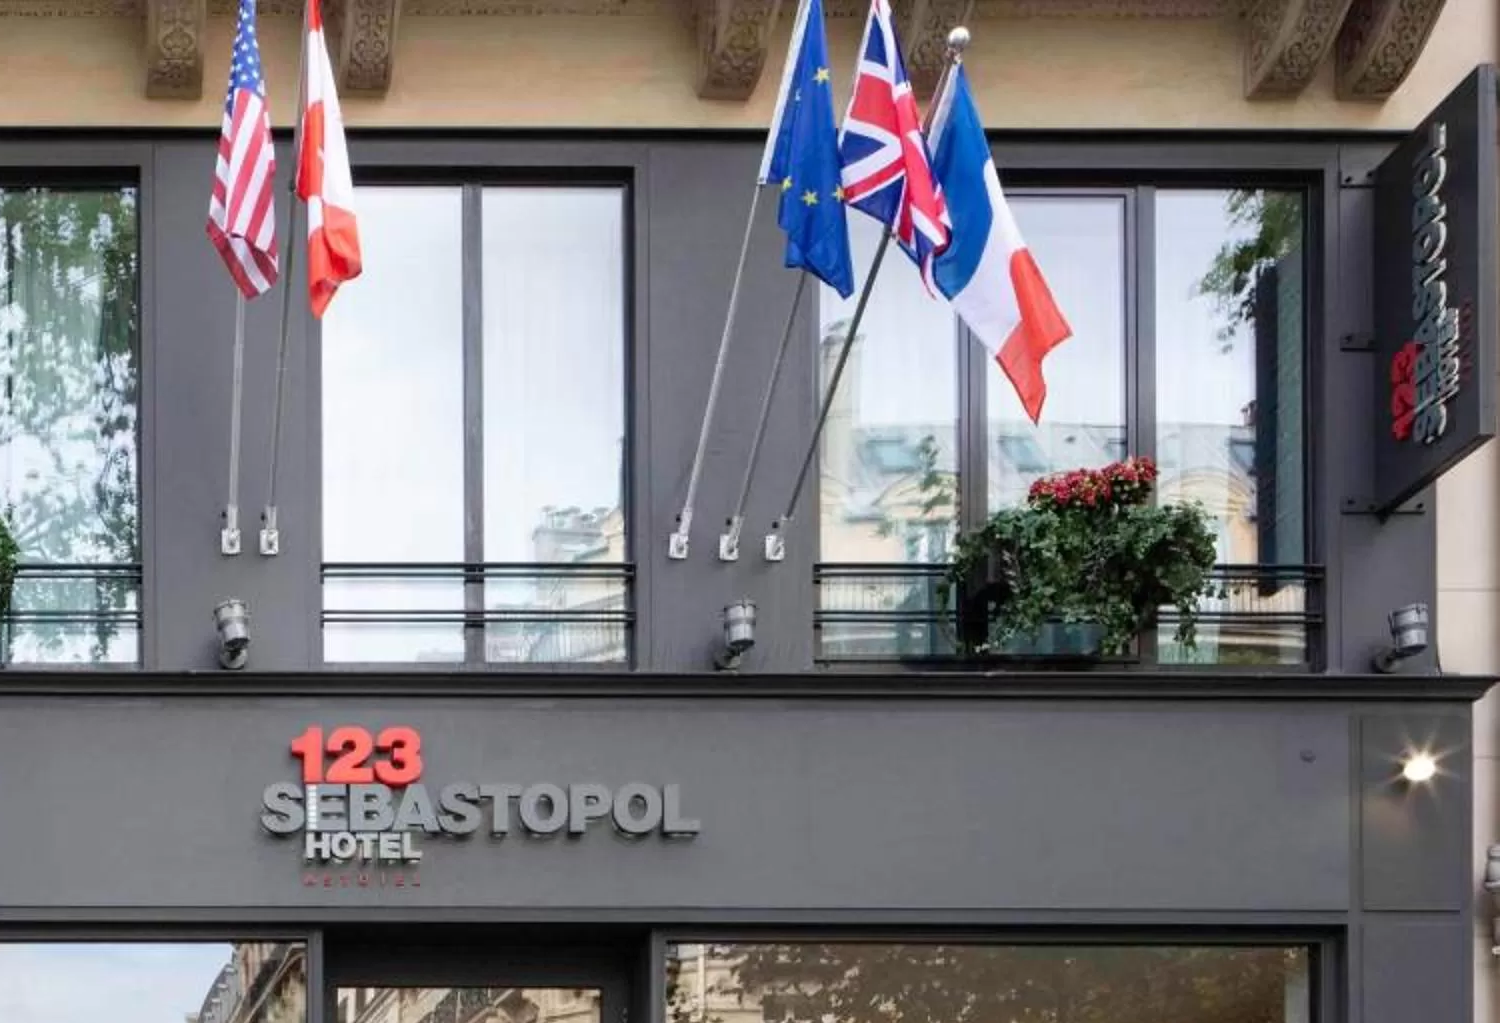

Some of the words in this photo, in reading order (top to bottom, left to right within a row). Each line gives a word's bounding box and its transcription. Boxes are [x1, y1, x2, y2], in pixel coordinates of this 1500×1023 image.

[1411, 121, 1447, 445] SEBASTOPOL
[1390, 339, 1424, 441] 123
[290, 725, 423, 785] 123
[261, 781, 699, 835] SEBASTOPOL
[305, 831, 422, 861] HOTEL
